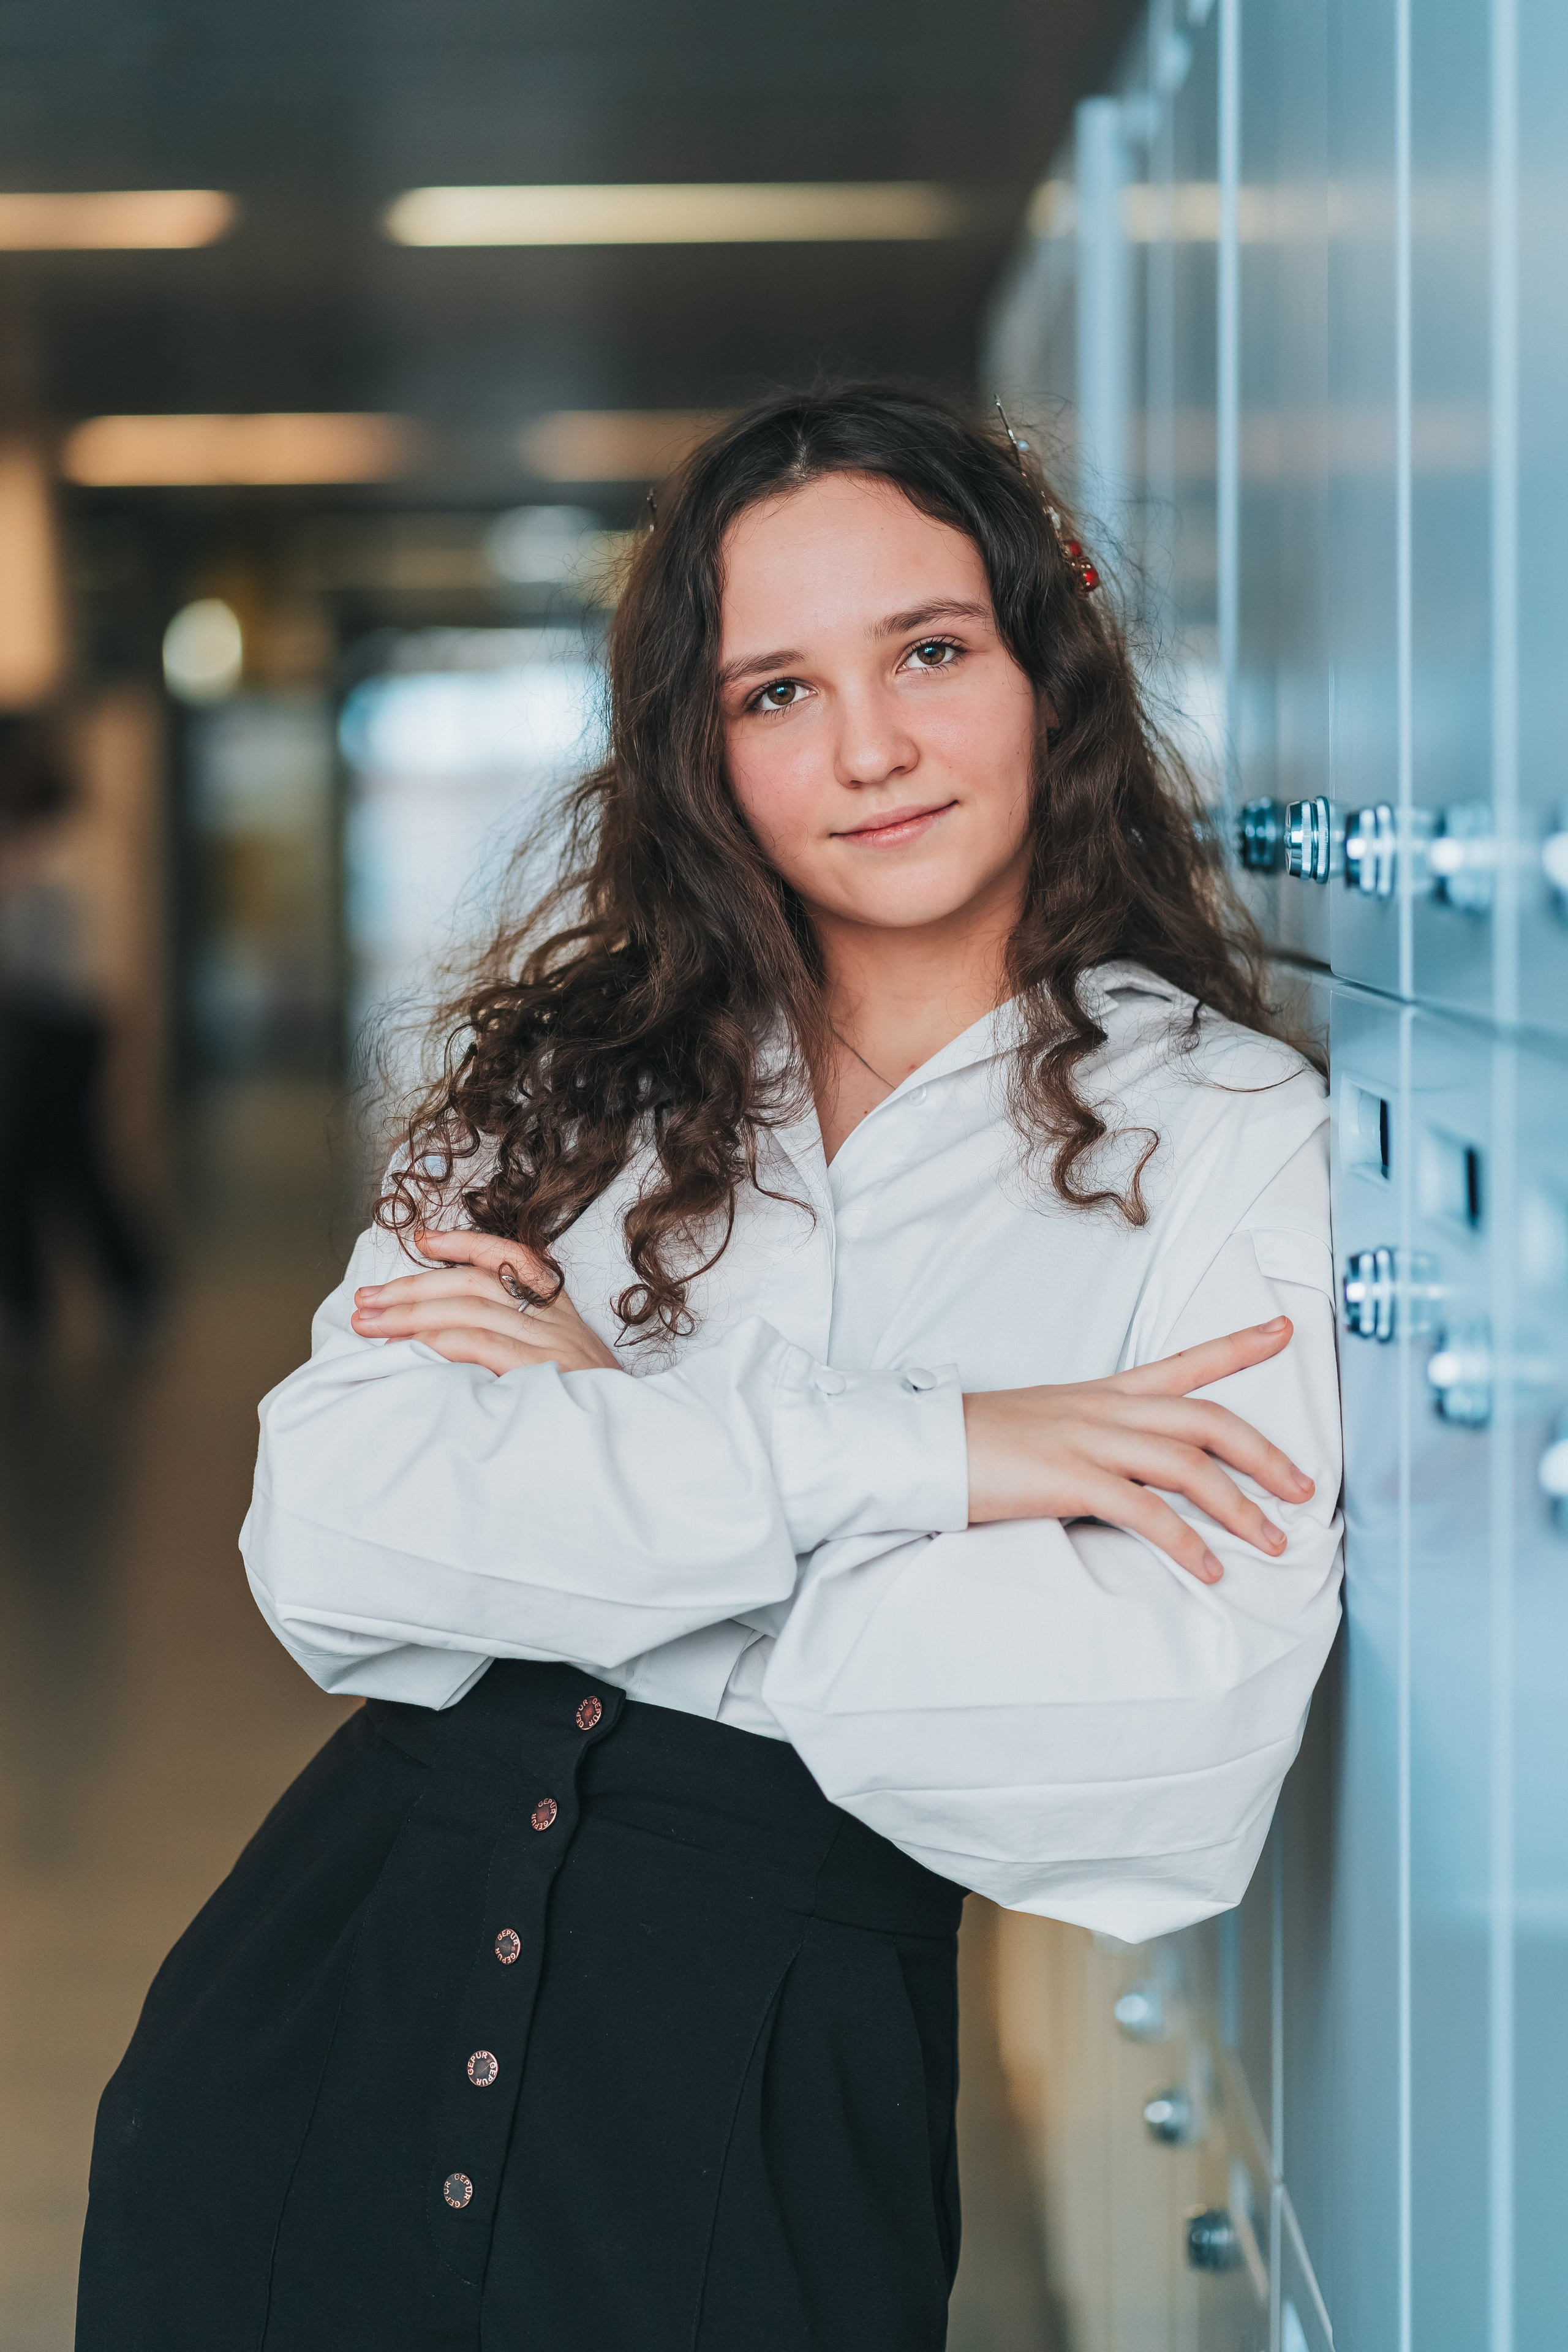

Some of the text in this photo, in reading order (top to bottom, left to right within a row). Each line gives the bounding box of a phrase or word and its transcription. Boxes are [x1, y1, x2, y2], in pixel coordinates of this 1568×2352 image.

[576, 1699, 589, 1728] GEPUR
[589, 1698, 600, 1727] GEPUR
[538, 1798, 556, 1814] GEPUR
[531, 1813, 549, 1830] GEPUR
[497, 1930, 518, 1946] GEPUR
[496, 1947, 516, 1964] GEPUR
[468, 2051, 488, 2075] GEPUR
[477, 2062, 497, 2086] GEPUR
[444, 2181, 460, 2207] GEPUR
[454, 2174, 472, 2200] GEPUR
